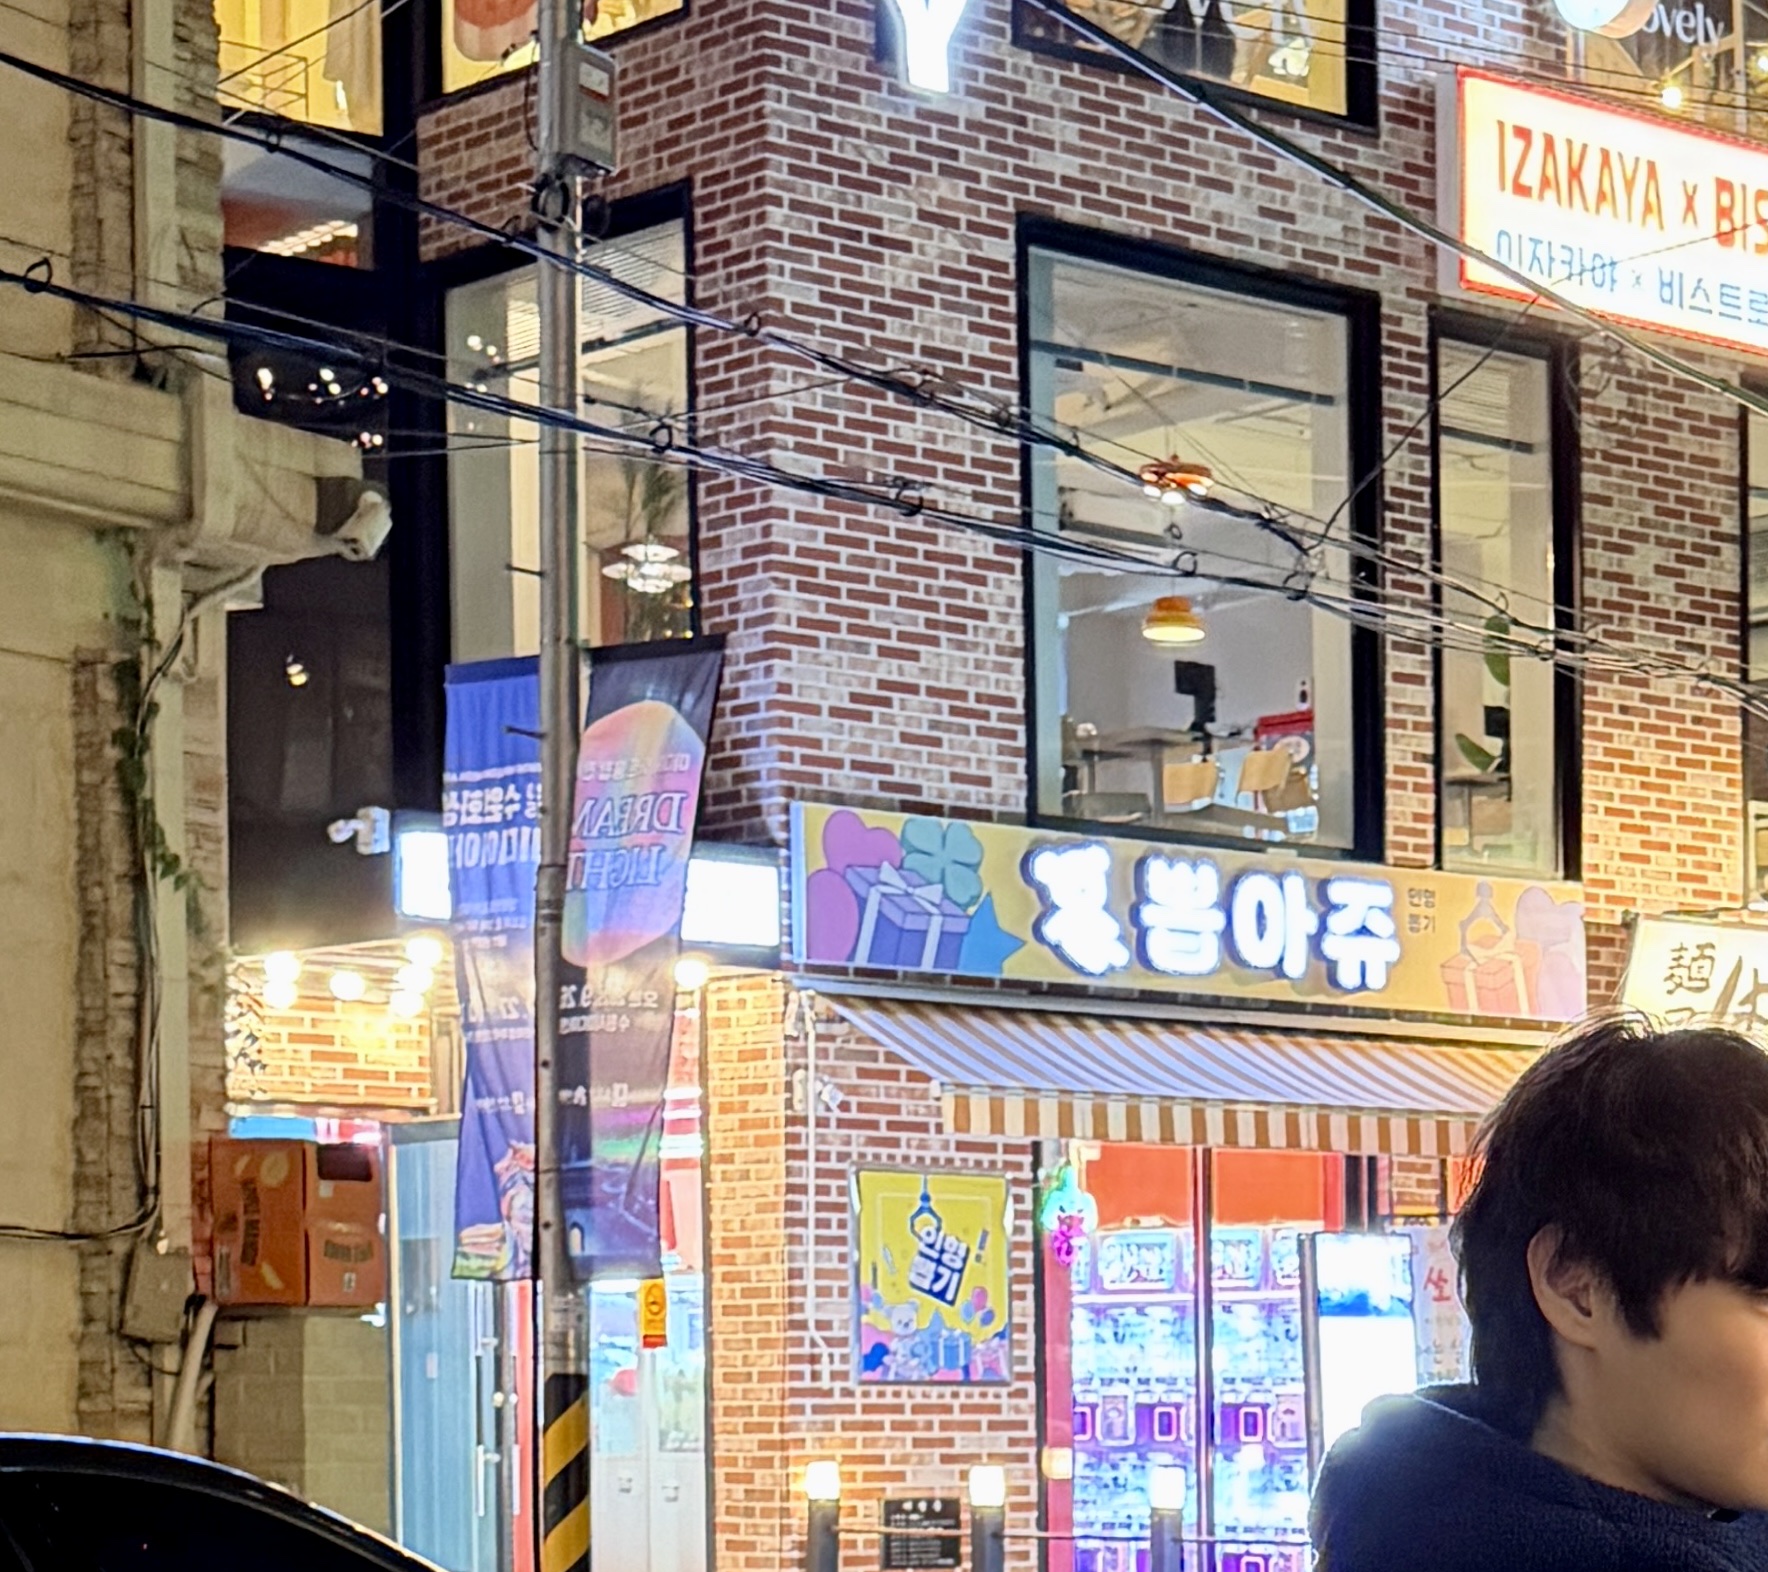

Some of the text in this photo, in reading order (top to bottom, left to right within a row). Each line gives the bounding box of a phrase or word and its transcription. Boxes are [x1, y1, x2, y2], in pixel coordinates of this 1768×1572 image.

[1642, 2, 1724, 48] ovely
[1496, 119, 1665, 233] IZAKAYA
[1496, 228, 1619, 294] 이자카야
[1137, 851, 1402, 991] 뽑아쥬
[1407, 887, 1437, 908] 인형
[918, 1225, 968, 1270] 인형
